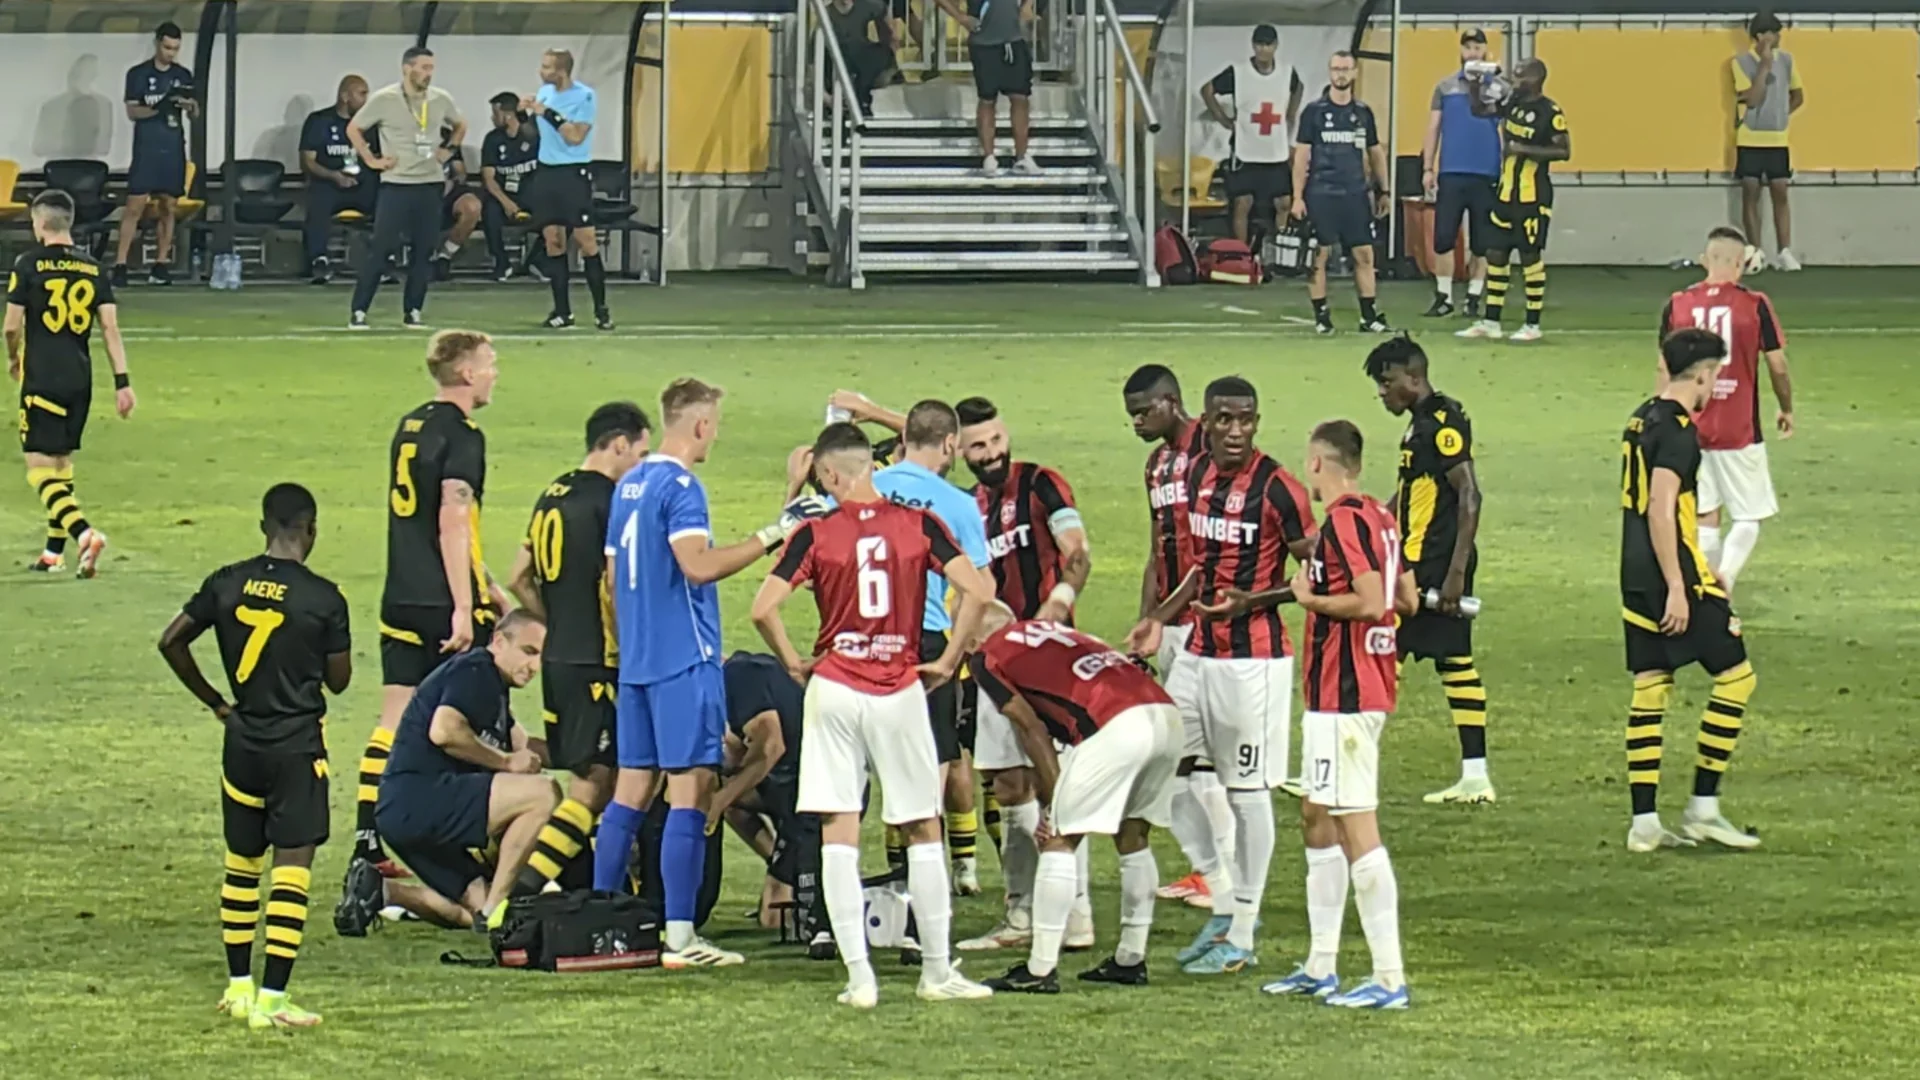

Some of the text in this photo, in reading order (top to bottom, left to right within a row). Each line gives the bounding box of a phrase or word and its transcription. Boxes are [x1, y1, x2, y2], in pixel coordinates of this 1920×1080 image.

[42, 278, 95, 334] 38
[392, 443, 418, 517] 5
[1150, 480, 1190, 509] INBE
[529, 508, 564, 582] 10
[620, 509, 640, 591] 1
[856, 535, 890, 619] 6
[243, 579, 288, 602] AKERE
[235, 604, 285, 684] 7
[1238, 743, 1259, 769] 91
[1315, 758, 1331, 782] 17
